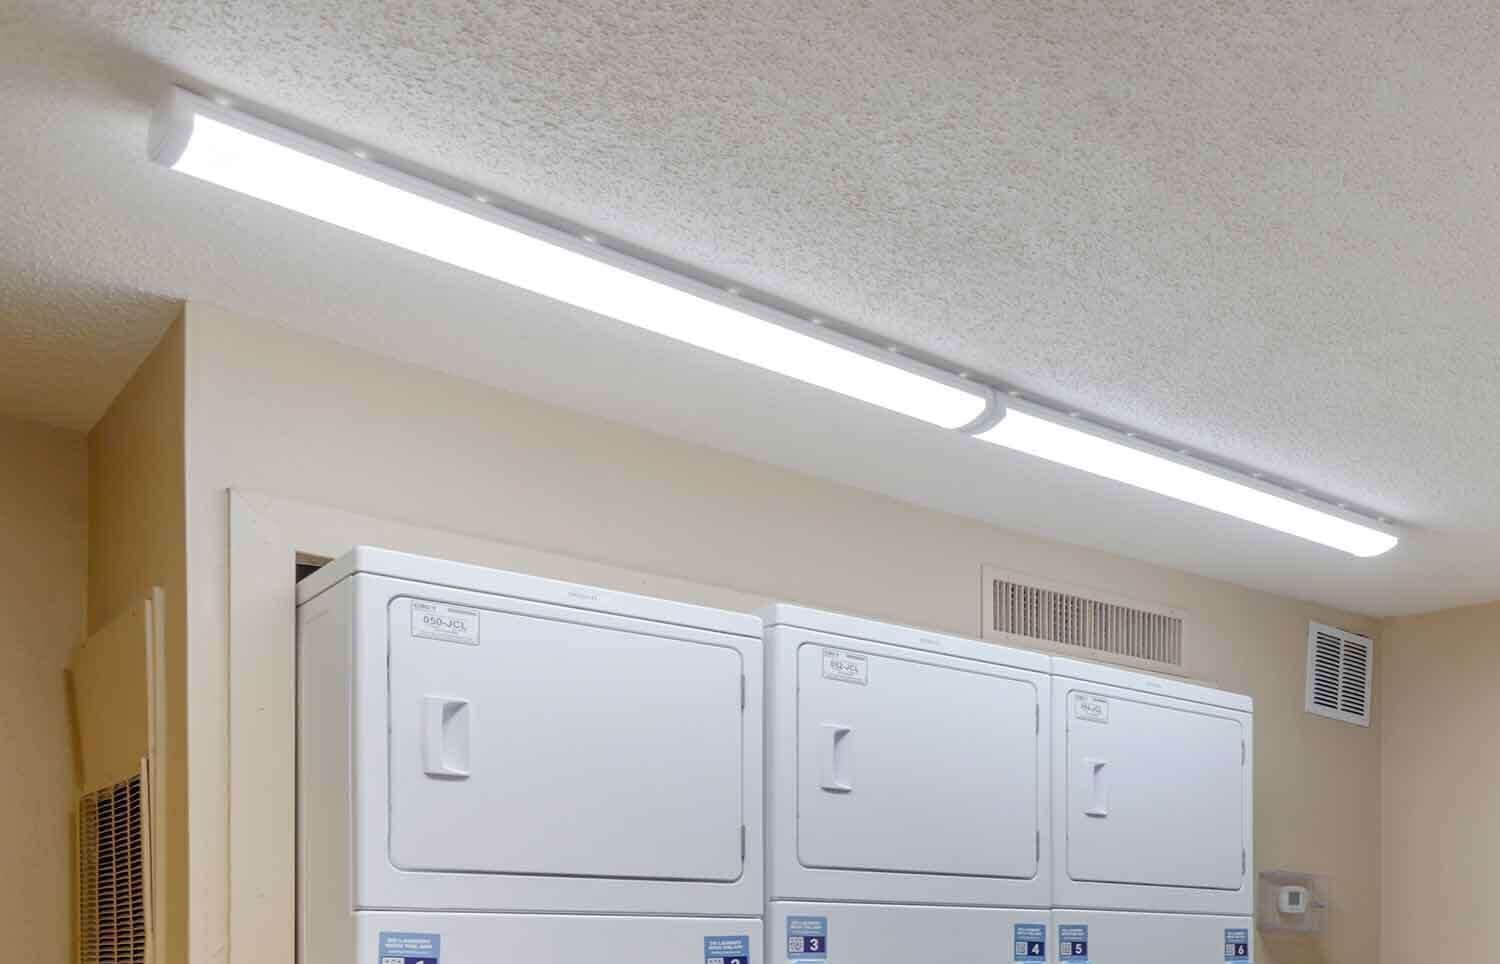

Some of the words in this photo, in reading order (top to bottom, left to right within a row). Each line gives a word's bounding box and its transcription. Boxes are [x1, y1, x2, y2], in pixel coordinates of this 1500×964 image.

[810, 938, 818, 951] 3
[1031, 943, 1040, 955] 4
[1075, 943, 1082, 954] 5
[1238, 944, 1244, 955] 6
